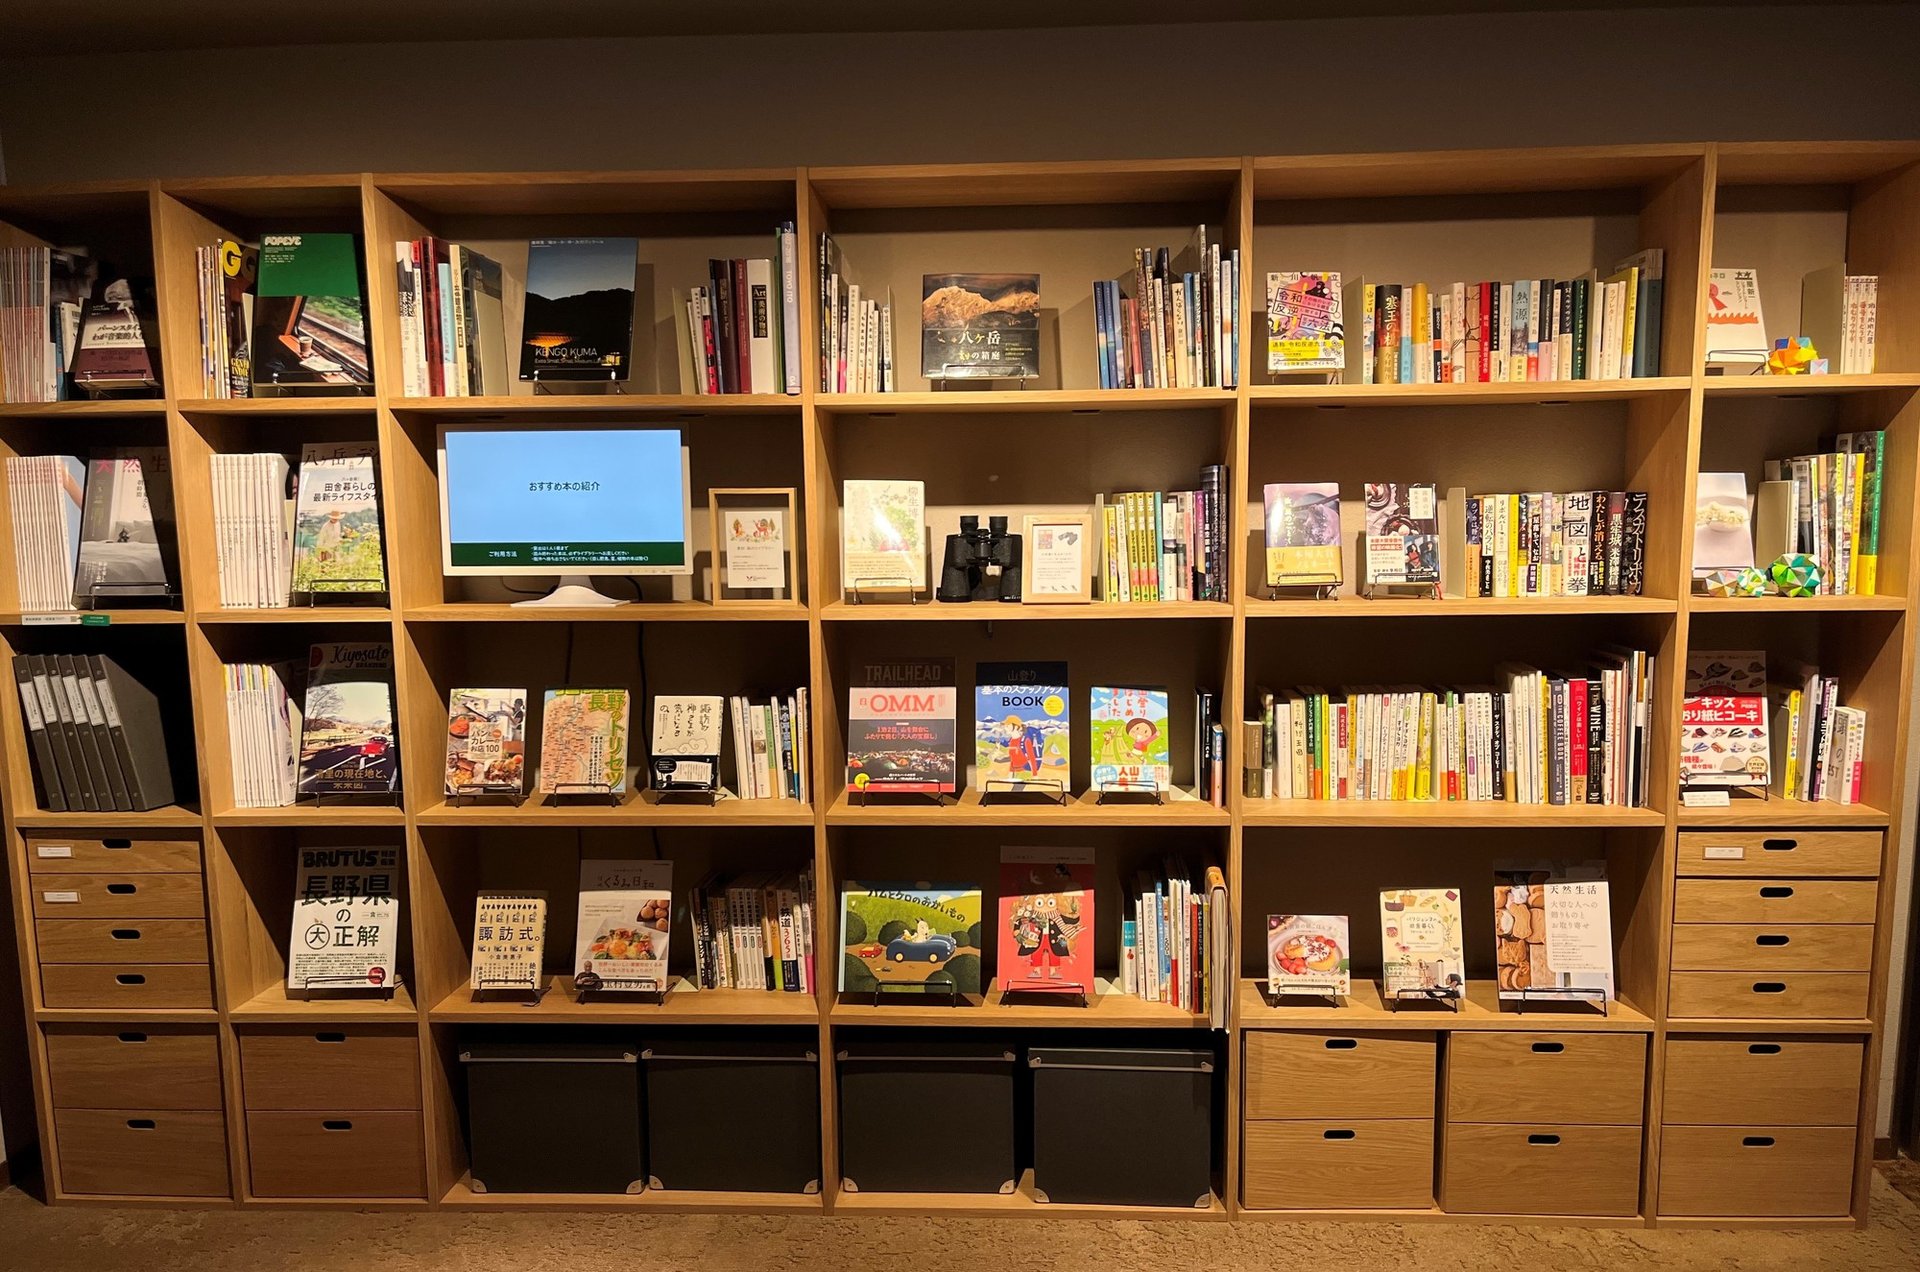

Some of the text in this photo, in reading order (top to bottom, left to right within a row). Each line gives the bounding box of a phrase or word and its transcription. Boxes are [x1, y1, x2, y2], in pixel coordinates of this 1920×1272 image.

[265, 236, 301, 245] POPEYE
[753, 289, 766, 297] Art
[1279, 291, 1302, 303] 令和
[1275, 303, 1299, 315] 反逆
[1516, 291, 1528, 320] 熱源
[1307, 319, 1330, 331] 六法
[959, 330, 1000, 345] 八ヶ岳
[535, 348, 597, 357] KENGO KUMA
[325, 483, 375, 492] 田舎暮らしの
[529, 481, 600, 491] おすすめ本の紹介
[1485, 505, 1493, 554] 逆転のバラッド
[1594, 494, 1606, 560] わたしが消える
[1608, 513, 1622, 546] 黒牢城
[1568, 496, 1589, 593] 地図と拳
[1629, 493, 1647, 593] テスカトリポカ
[1608, 548, 1620, 586] 米澤穂信
[330, 646, 389, 668] Kiyosato
[864, 665, 941, 681] TRAILHEAD
[1007, 670, 1036, 681] 山登り
[589, 694, 626, 712] 長野
[870, 694, 935, 712] OMM
[1002, 697, 1044, 707] BOOK
[1701, 697, 1735, 708] キッズ
[1590, 705, 1601, 731] WINE
[1683, 710, 1758, 722] おり紙ヒコーキ
[605, 711, 625, 789] のトリセツ
[315, 769, 387, 779] 清里の現在地と、
[303, 851, 377, 868] BRUTUS
[301, 875, 391, 906] 長野県
[1550, 885, 1597, 895] 天然生活
[1551, 901, 1598, 909] 大切な人への
[336, 909, 351, 922] の
[1551, 911, 1584, 919] 贈りものと
[1552, 922, 1590, 930] お取り寄せ
[479, 927, 540, 941] 諏訪式。
